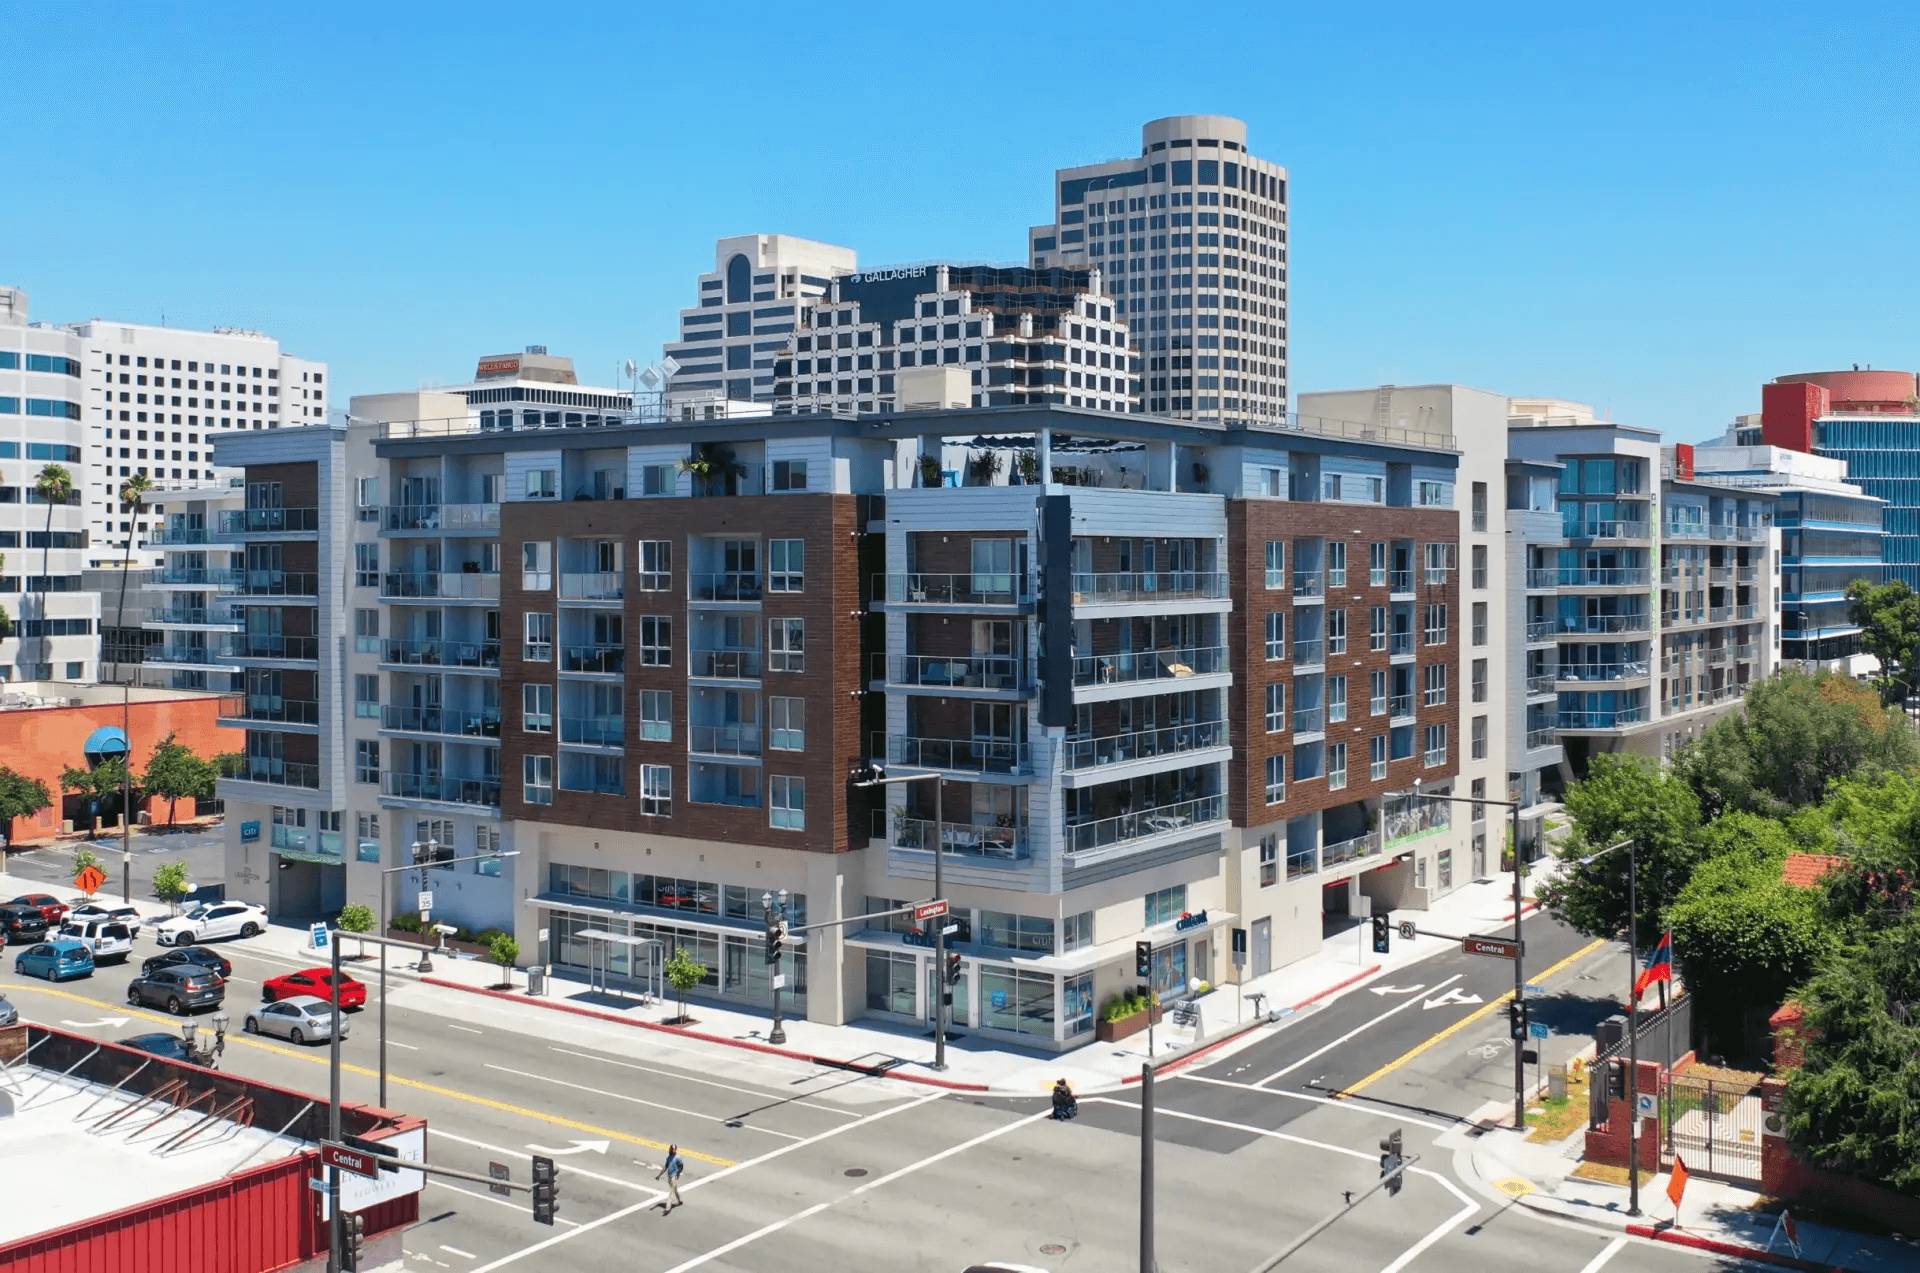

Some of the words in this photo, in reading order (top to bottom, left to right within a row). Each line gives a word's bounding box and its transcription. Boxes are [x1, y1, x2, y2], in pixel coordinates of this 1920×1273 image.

[864, 266, 927, 283] GALLAGHER
[244, 828, 257, 836] citi
[421, 900, 432, 908] 35
[920, 905, 944, 917] Lexington
[1176, 909, 1208, 931] citibank
[1475, 942, 1505, 954] Central
[333, 1150, 362, 1169] Central
